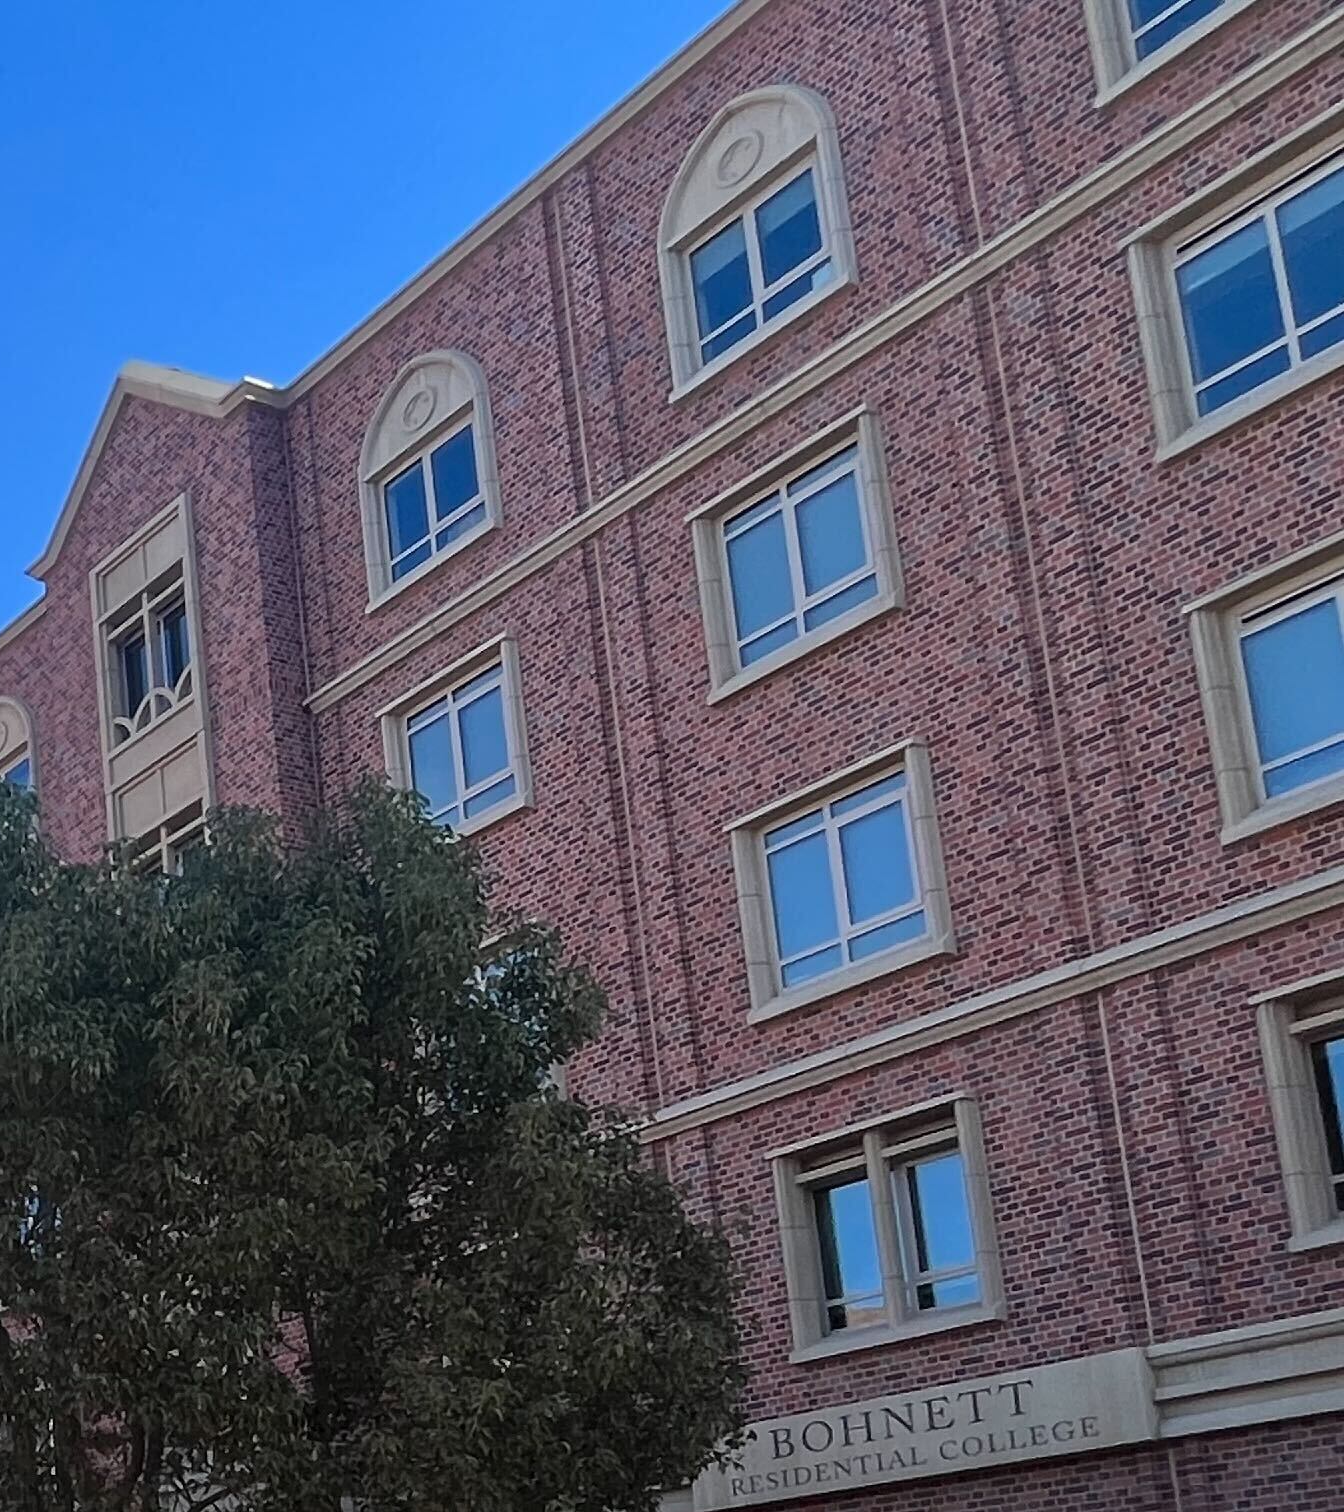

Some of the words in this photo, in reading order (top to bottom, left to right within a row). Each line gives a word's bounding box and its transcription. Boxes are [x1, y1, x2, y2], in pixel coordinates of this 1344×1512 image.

[731, 1446, 928, 1497] RESIDENTIAL
[939, 1415, 1102, 1461] COLLEGE
[768, 1379, 1034, 1460] BOHNETT
